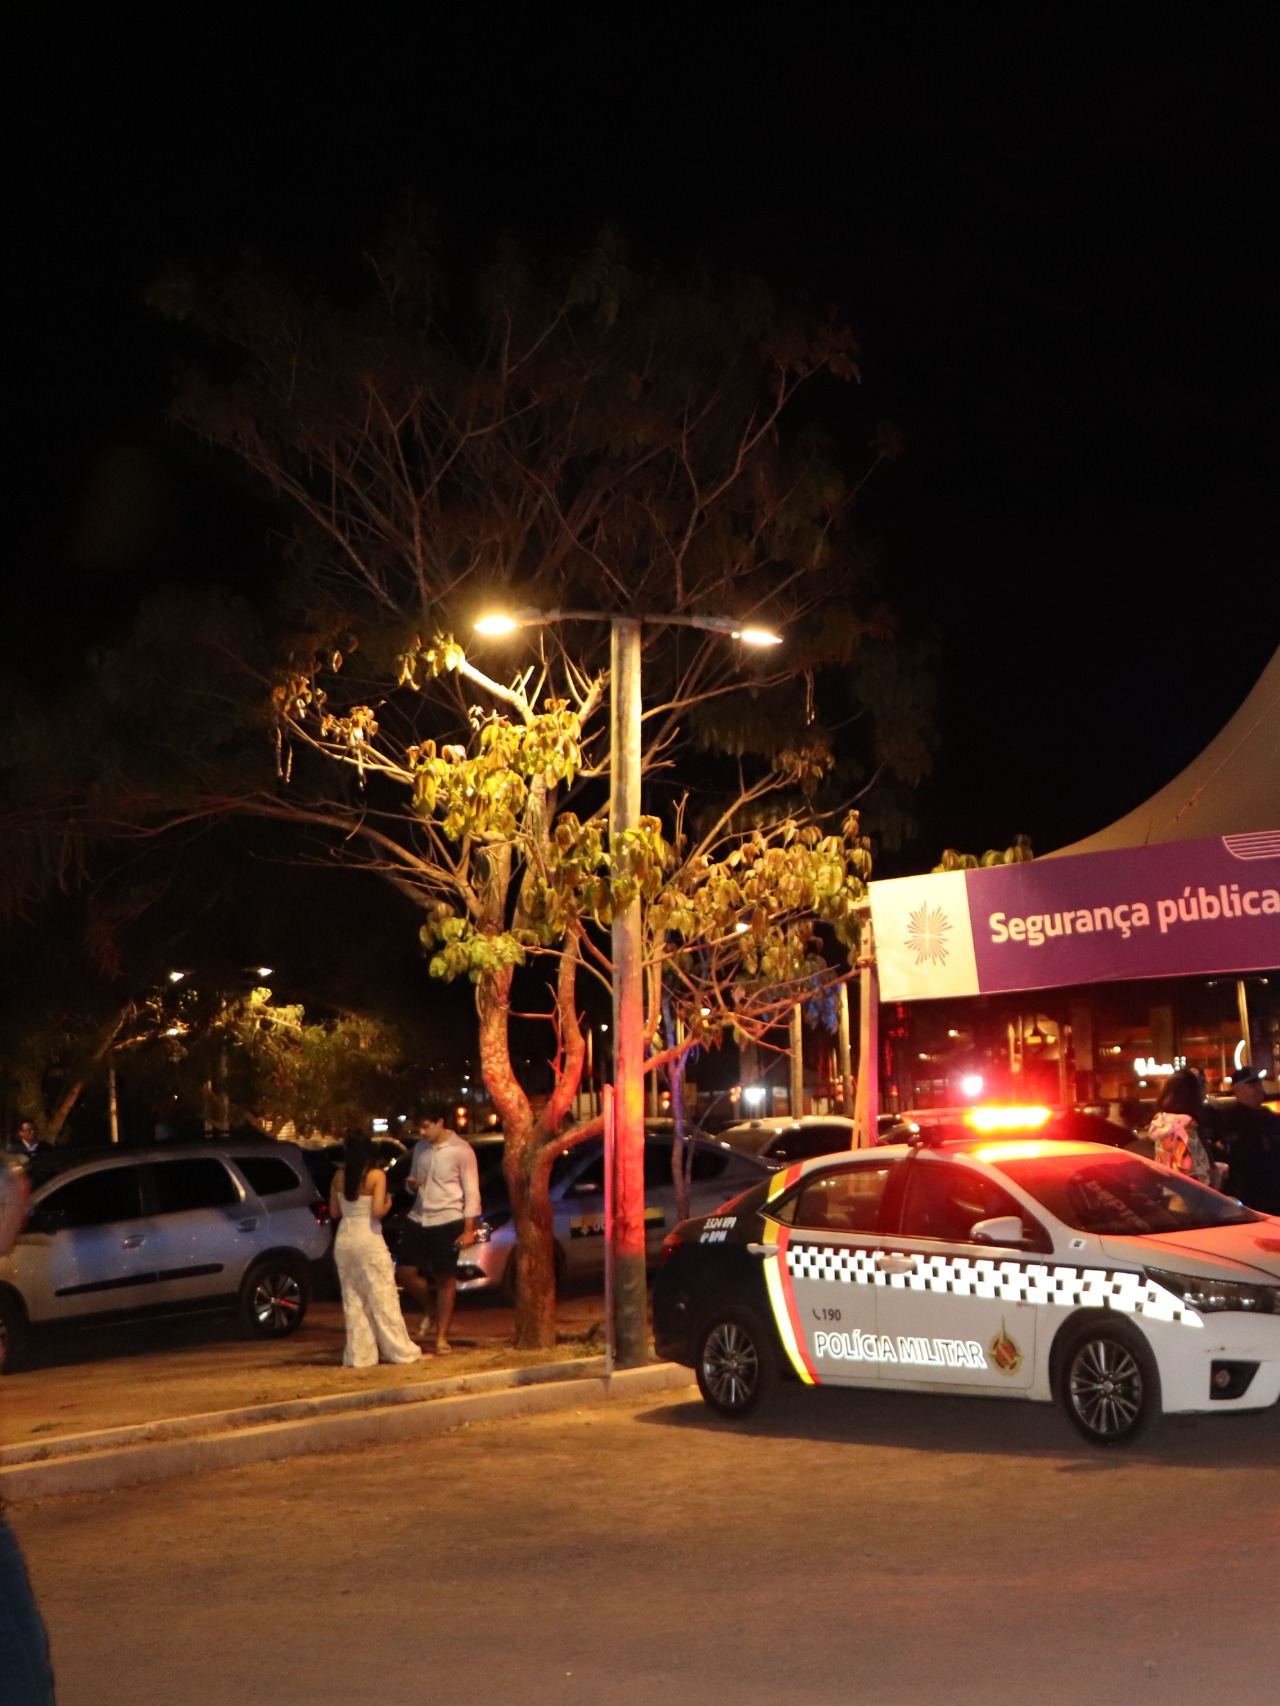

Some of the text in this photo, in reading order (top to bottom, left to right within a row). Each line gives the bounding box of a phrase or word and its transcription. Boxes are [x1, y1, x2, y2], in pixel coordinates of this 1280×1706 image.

[988, 902, 1150, 947] Segurança
[822, 1308, 841, 1321] 190
[814, 1328, 987, 1370] POLÍCIA MILITAR
